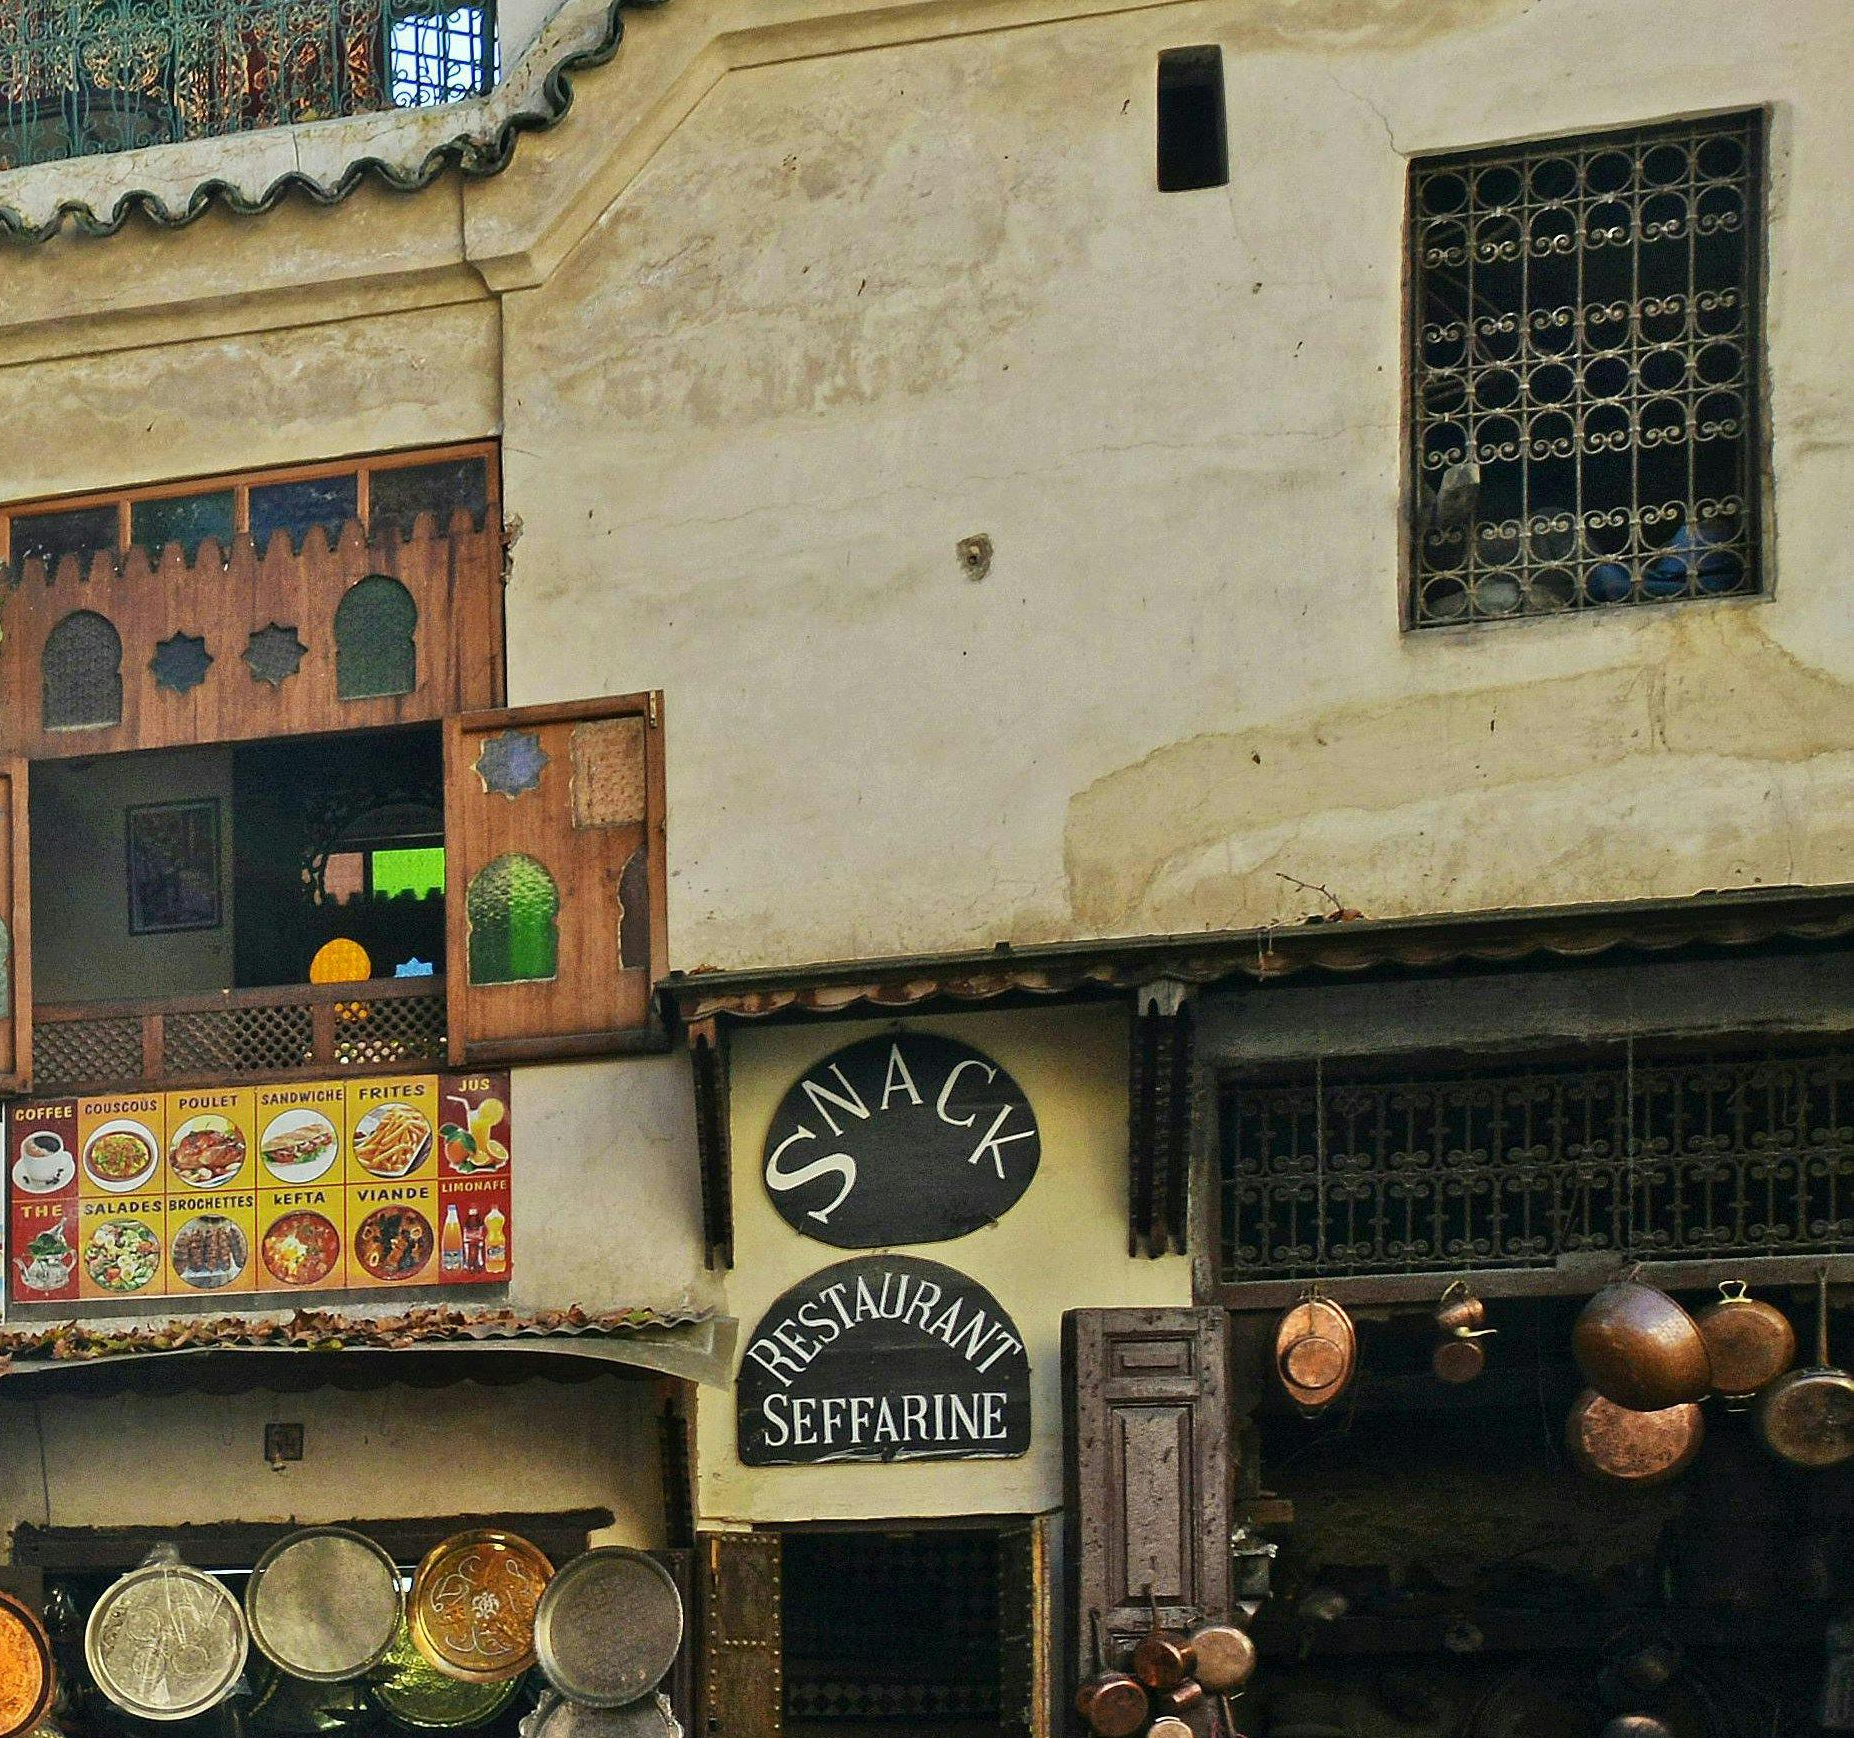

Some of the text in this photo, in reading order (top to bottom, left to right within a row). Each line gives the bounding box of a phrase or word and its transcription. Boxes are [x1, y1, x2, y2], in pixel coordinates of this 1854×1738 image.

[359, 1083, 425, 1100] FRITES
[458, 1078, 490, 1092] JUS
[179, 1095, 238, 1110] POULET
[261, 1089, 343, 1106] SANDWICHE
[15, 1105, 72, 1121] COFFEE
[85, 1099, 157, 1115] COUSCOUS
[766, 1043, 1035, 1224] SNACK
[358, 1187, 429, 1201] VIANDE
[84, 1200, 162, 1216] SALADES
[169, 1195, 254, 1211] BROCHETTES
[21, 1204, 63, 1219] THE
[748, 1272, 1024, 1388] RESTAURANT
[763, 1392, 1008, 1447] SEFFARINE
